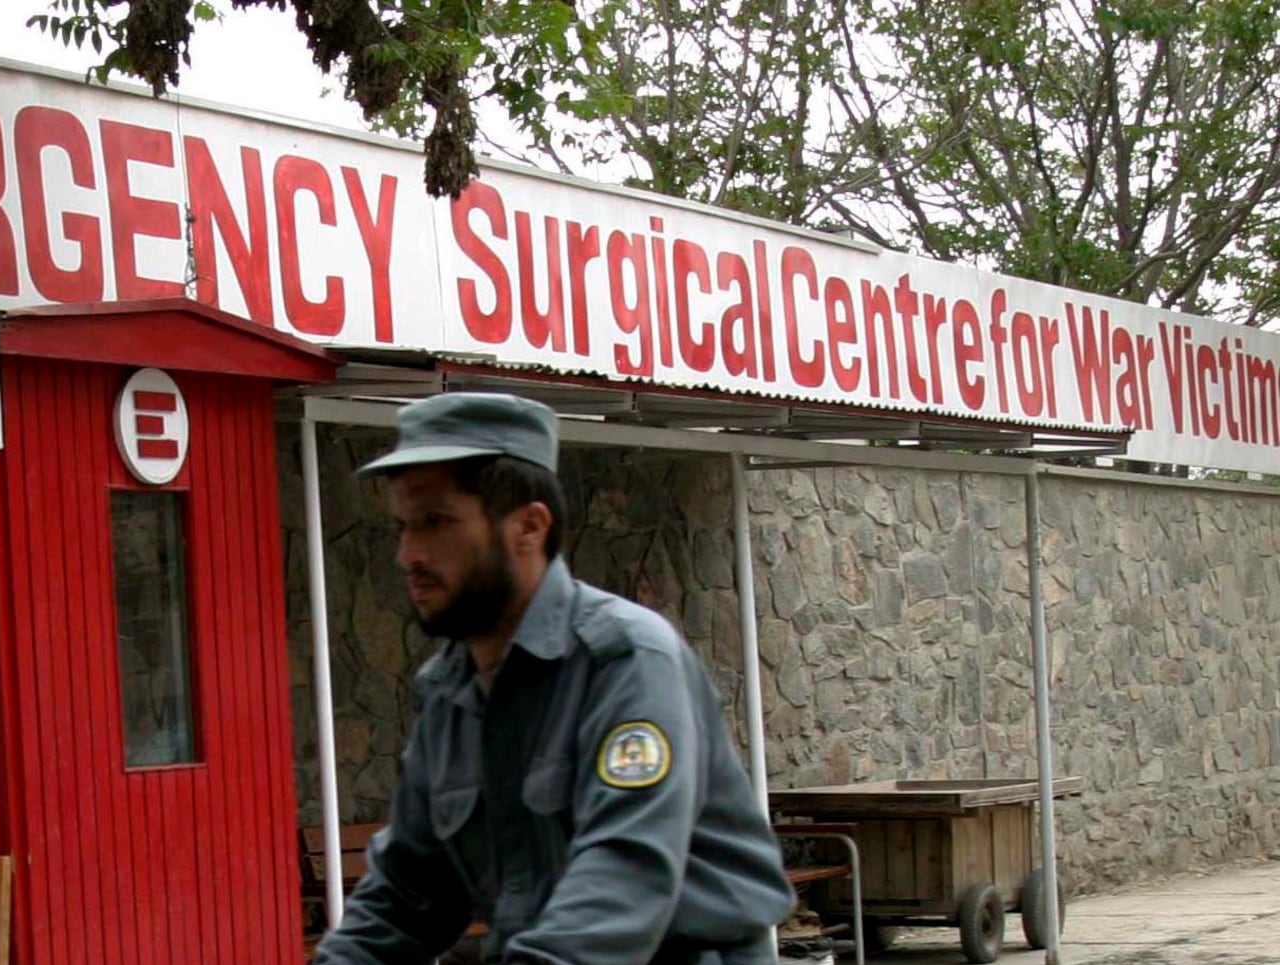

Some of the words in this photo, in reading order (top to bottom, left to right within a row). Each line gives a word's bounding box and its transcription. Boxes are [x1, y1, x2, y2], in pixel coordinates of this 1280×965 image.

[451, 180, 776, 383] Surgical
[781, 246, 985, 411] Centre
[990, 287, 1060, 419] for
[1065, 302, 1155, 432] War
[1158, 321, 1280, 448] Victim
